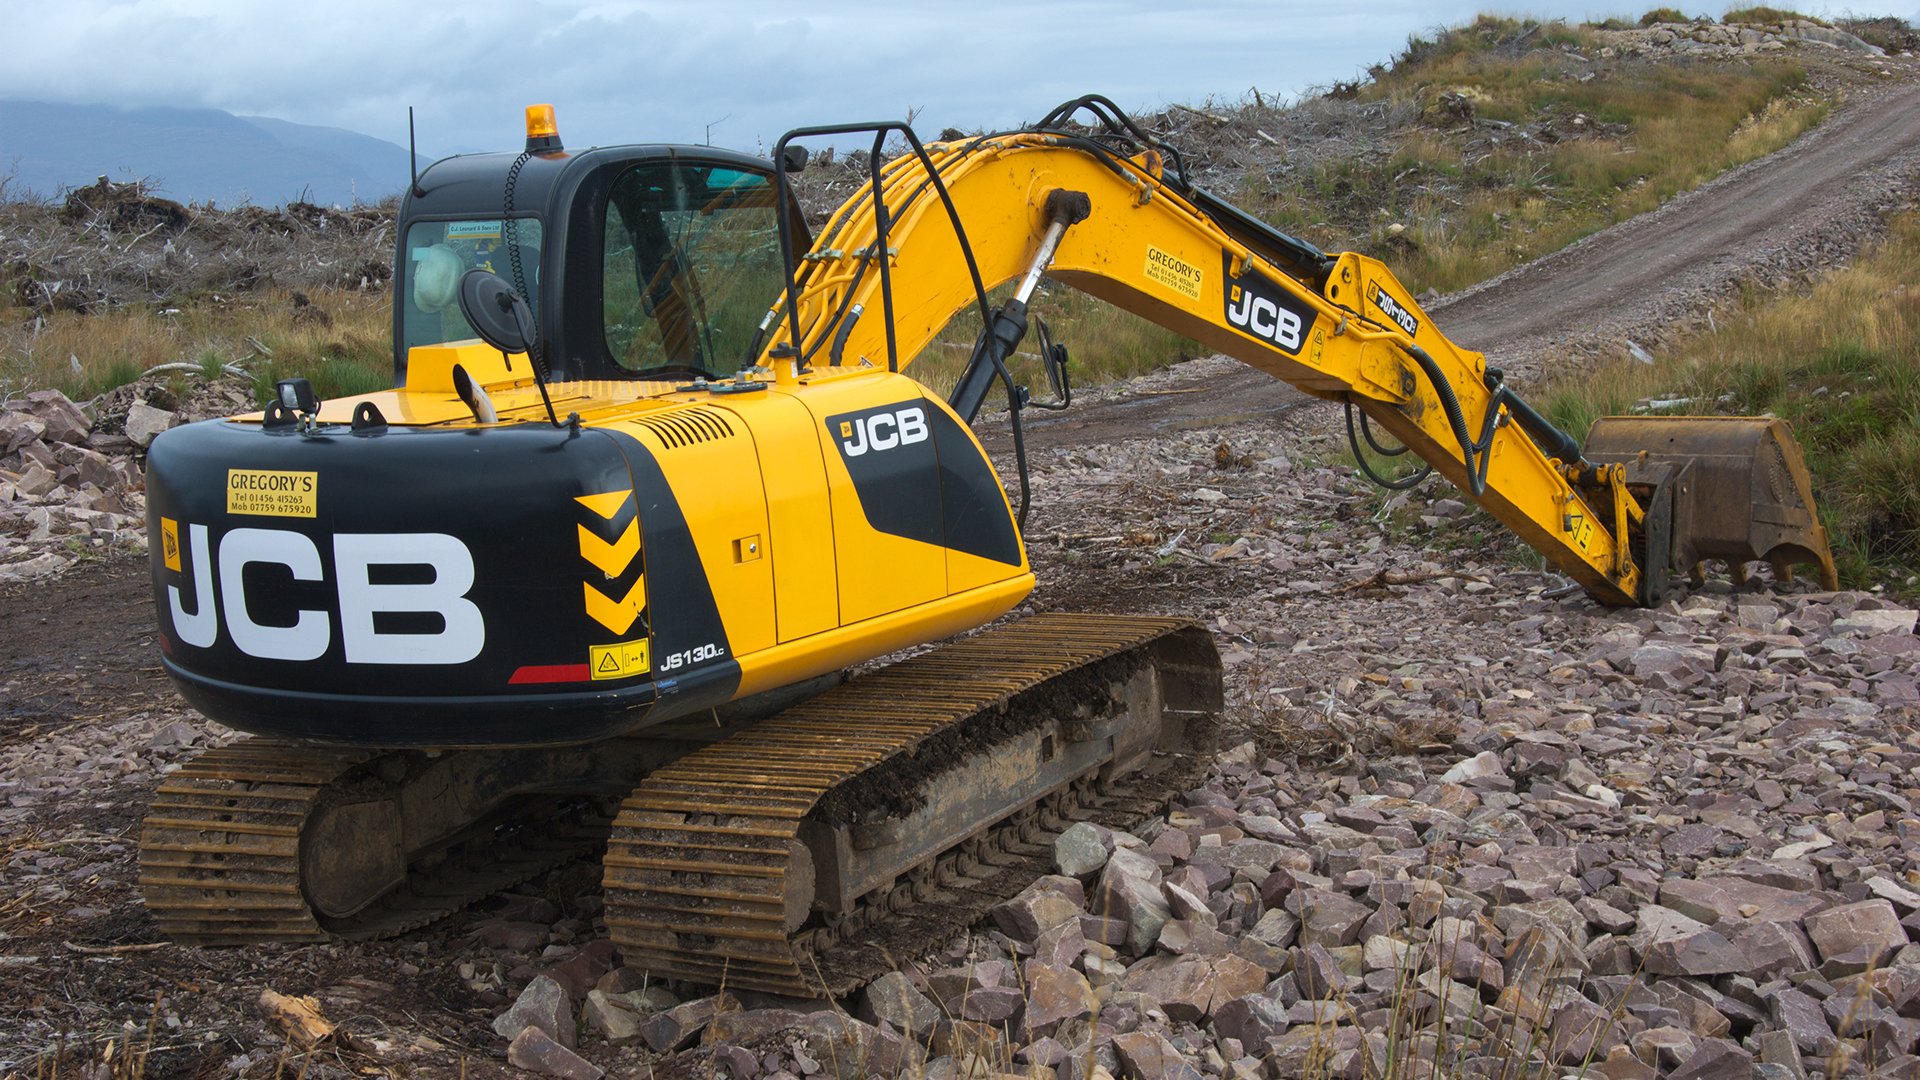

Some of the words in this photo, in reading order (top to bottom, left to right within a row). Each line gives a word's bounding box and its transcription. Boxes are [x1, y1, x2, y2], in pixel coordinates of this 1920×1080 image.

[1148, 248, 1201, 282] GREGORY'S
[1151, 263, 1160, 272] Tel
[1147, 269, 1159, 280] Mob
[1160, 275, 1177, 287] 07759
[1228, 290, 1302, 350] JCB
[843, 407, 929, 457] JCB
[231, 473, 312, 492] GREGORY'S
[231, 502, 248, 511] Mob
[250, 503, 275, 512] 07759
[278, 504, 312, 514] 675920
[235, 493, 247, 502] Tel
[250, 493, 274, 503] 01456
[277, 495, 303, 504] 415263
[168, 523, 486, 665] JCB
